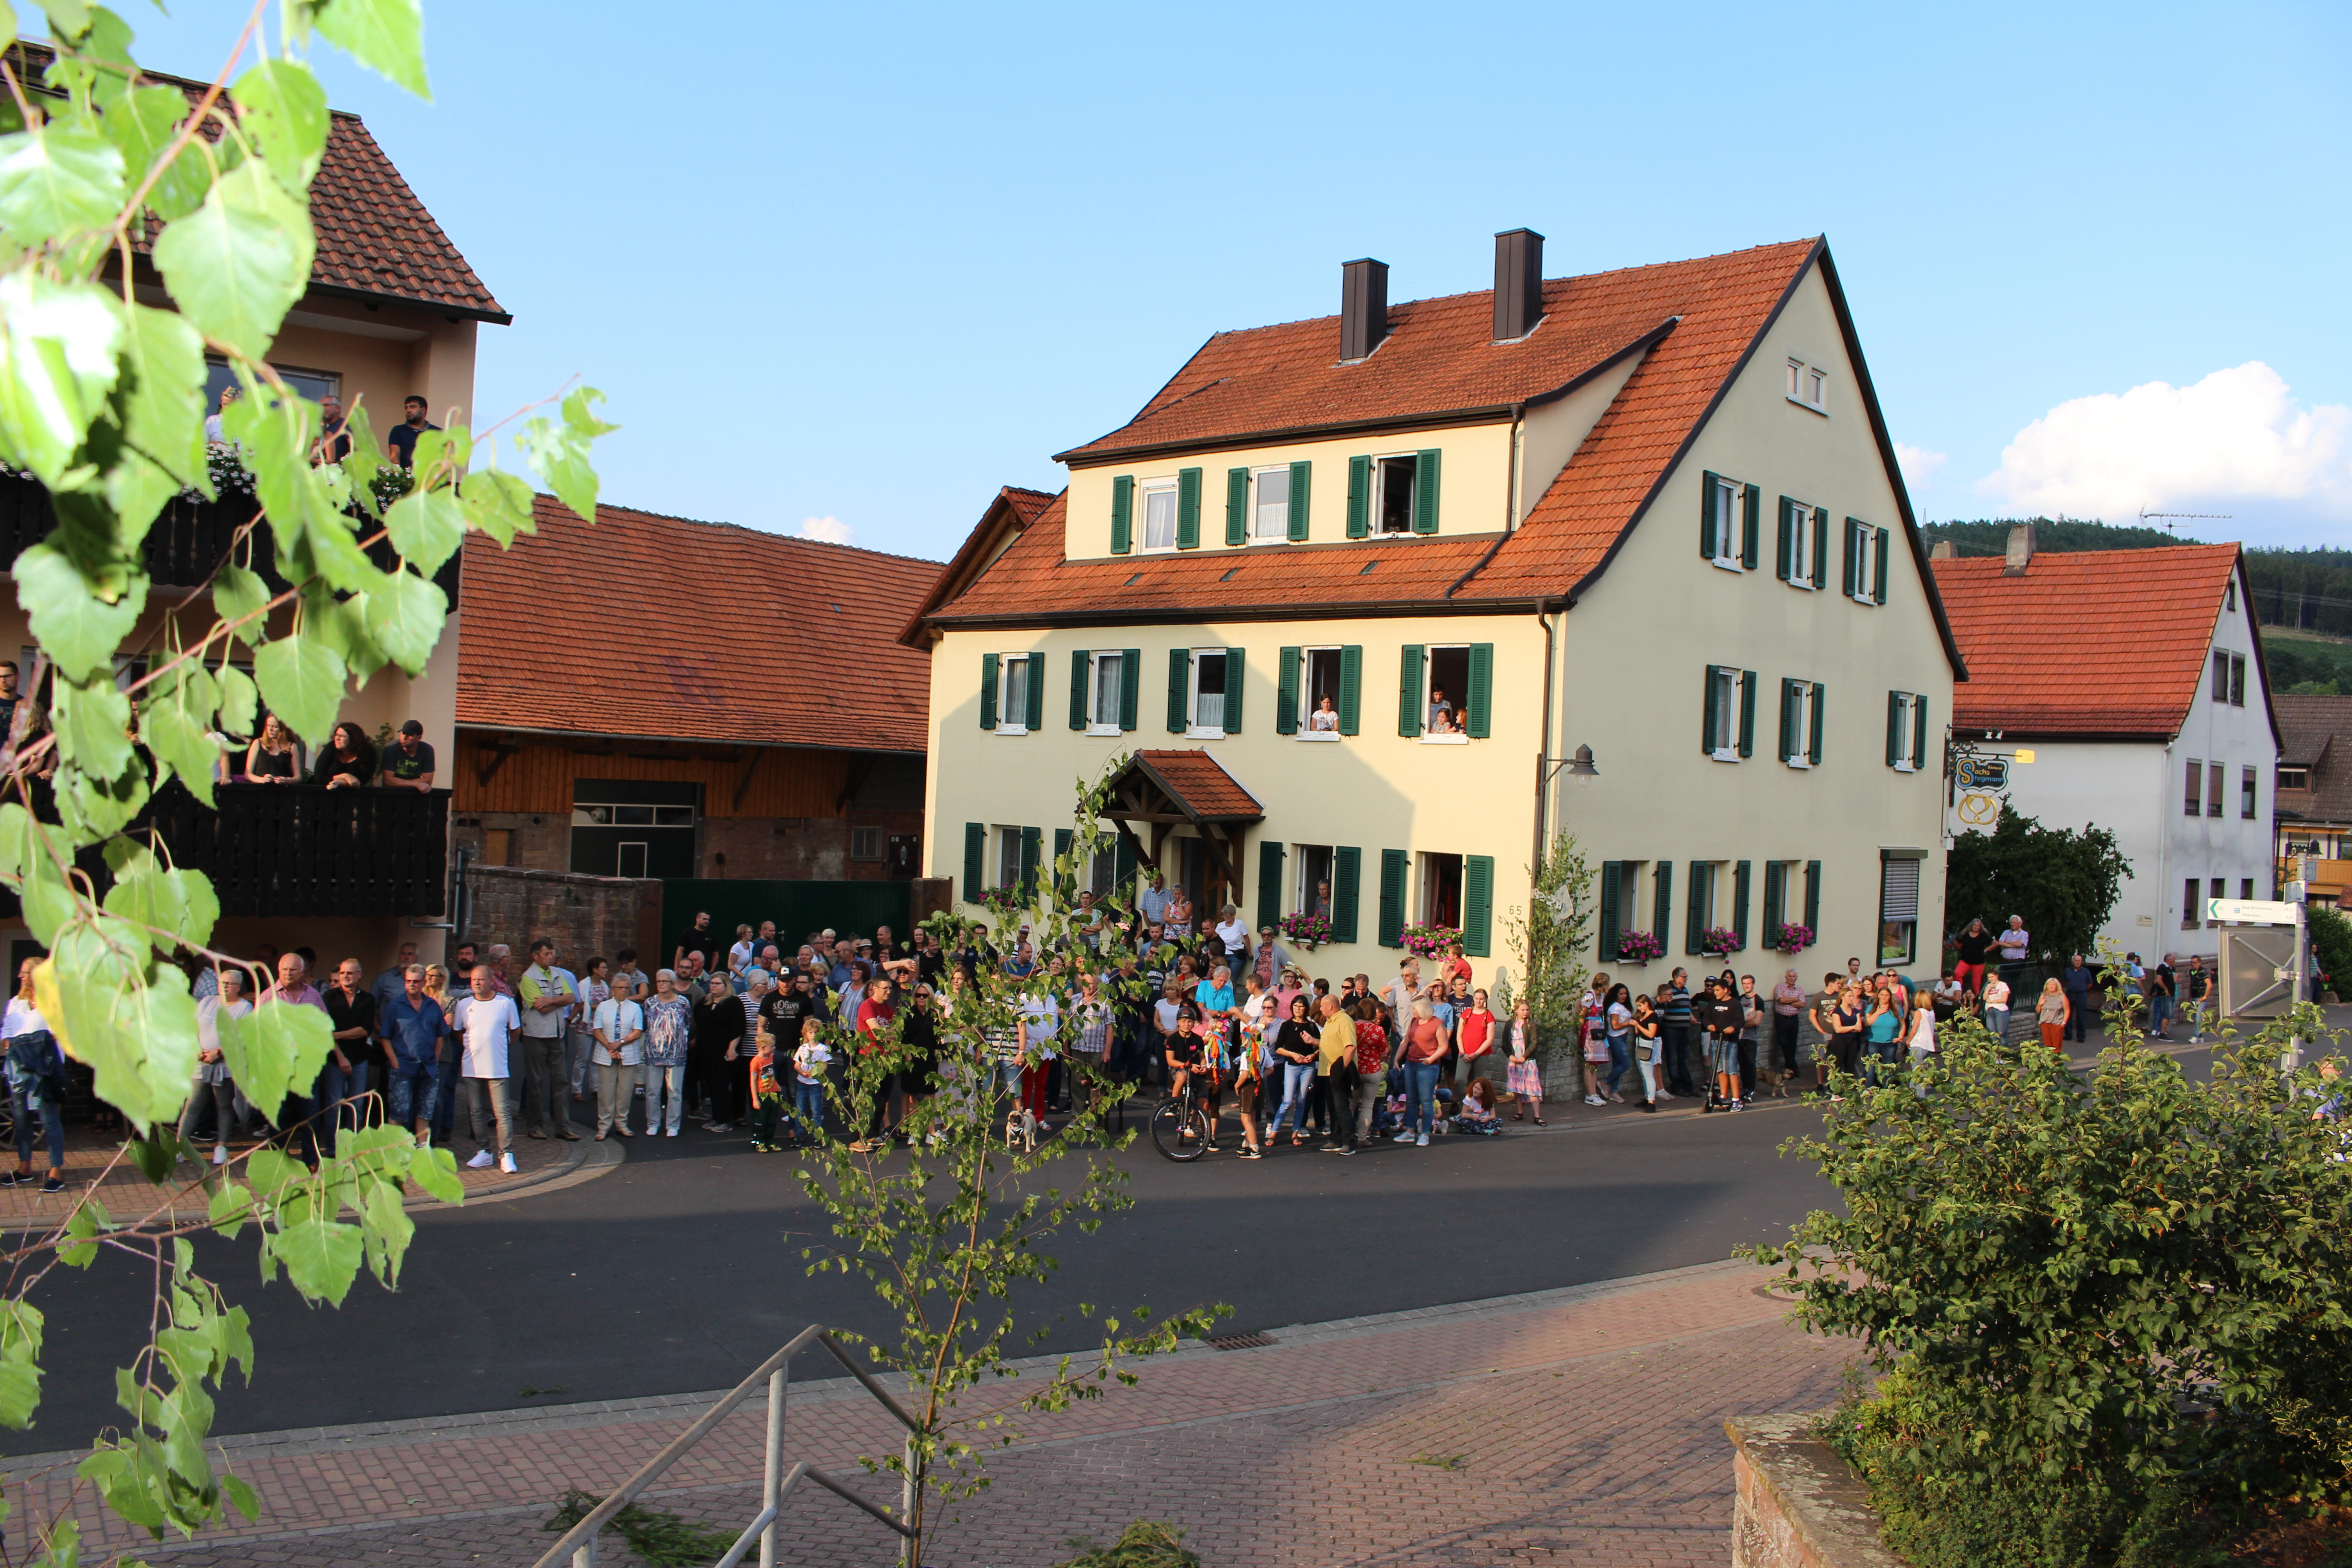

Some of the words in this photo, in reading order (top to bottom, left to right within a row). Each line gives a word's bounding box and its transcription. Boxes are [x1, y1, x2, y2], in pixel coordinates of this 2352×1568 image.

[1957, 763, 2004, 787] Stegmann
[1509, 905, 1522, 916] 65
[773, 1000, 799, 1009] s.Oliver
